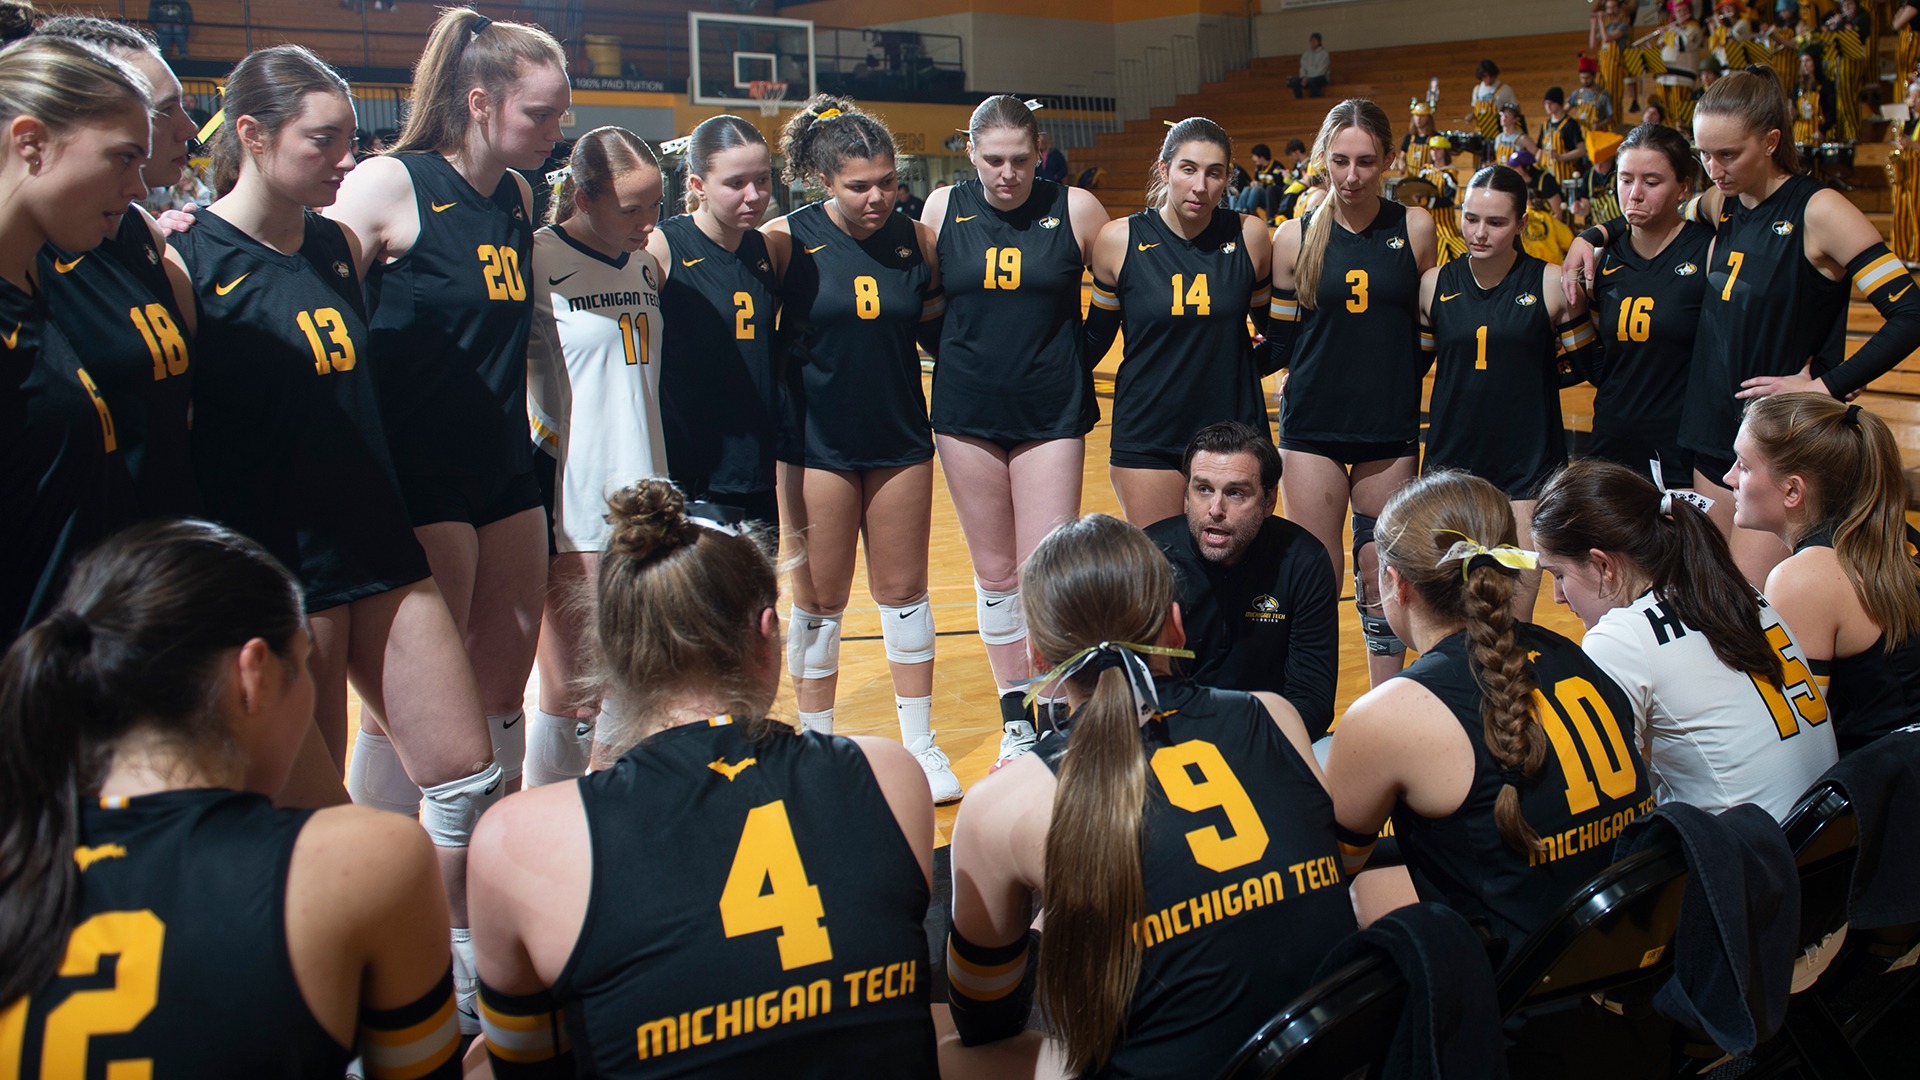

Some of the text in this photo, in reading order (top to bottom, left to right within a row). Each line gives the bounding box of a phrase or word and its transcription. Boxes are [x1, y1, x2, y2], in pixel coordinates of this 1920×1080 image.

[576, 78, 664, 91] 100% PAID TUITION
[477, 243, 527, 302] 20
[984, 247, 1022, 291] 19
[1171, 273, 1211, 316] 14
[1345, 270, 1369, 314] 3
[1721, 251, 1745, 302] 7
[568, 291, 660, 312] MICHIGAN TEC
[733, 292, 755, 340] 2
[853, 276, 881, 320] 8
[1616, 296, 1655, 342] 16
[130, 303, 188, 380] 18
[295, 307, 356, 376] 13
[617, 312, 650, 365] 11
[1474, 326, 1488, 370] 1
[1528, 675, 1637, 816] 10
[1149, 738, 1270, 875] 9
[1529, 796, 1654, 867] MICHIGAN TE
[719, 800, 833, 972] 4
[1133, 855, 1340, 948] MICHIGAN TECH
[636, 959, 916, 1061] MICHIGAN TECH
